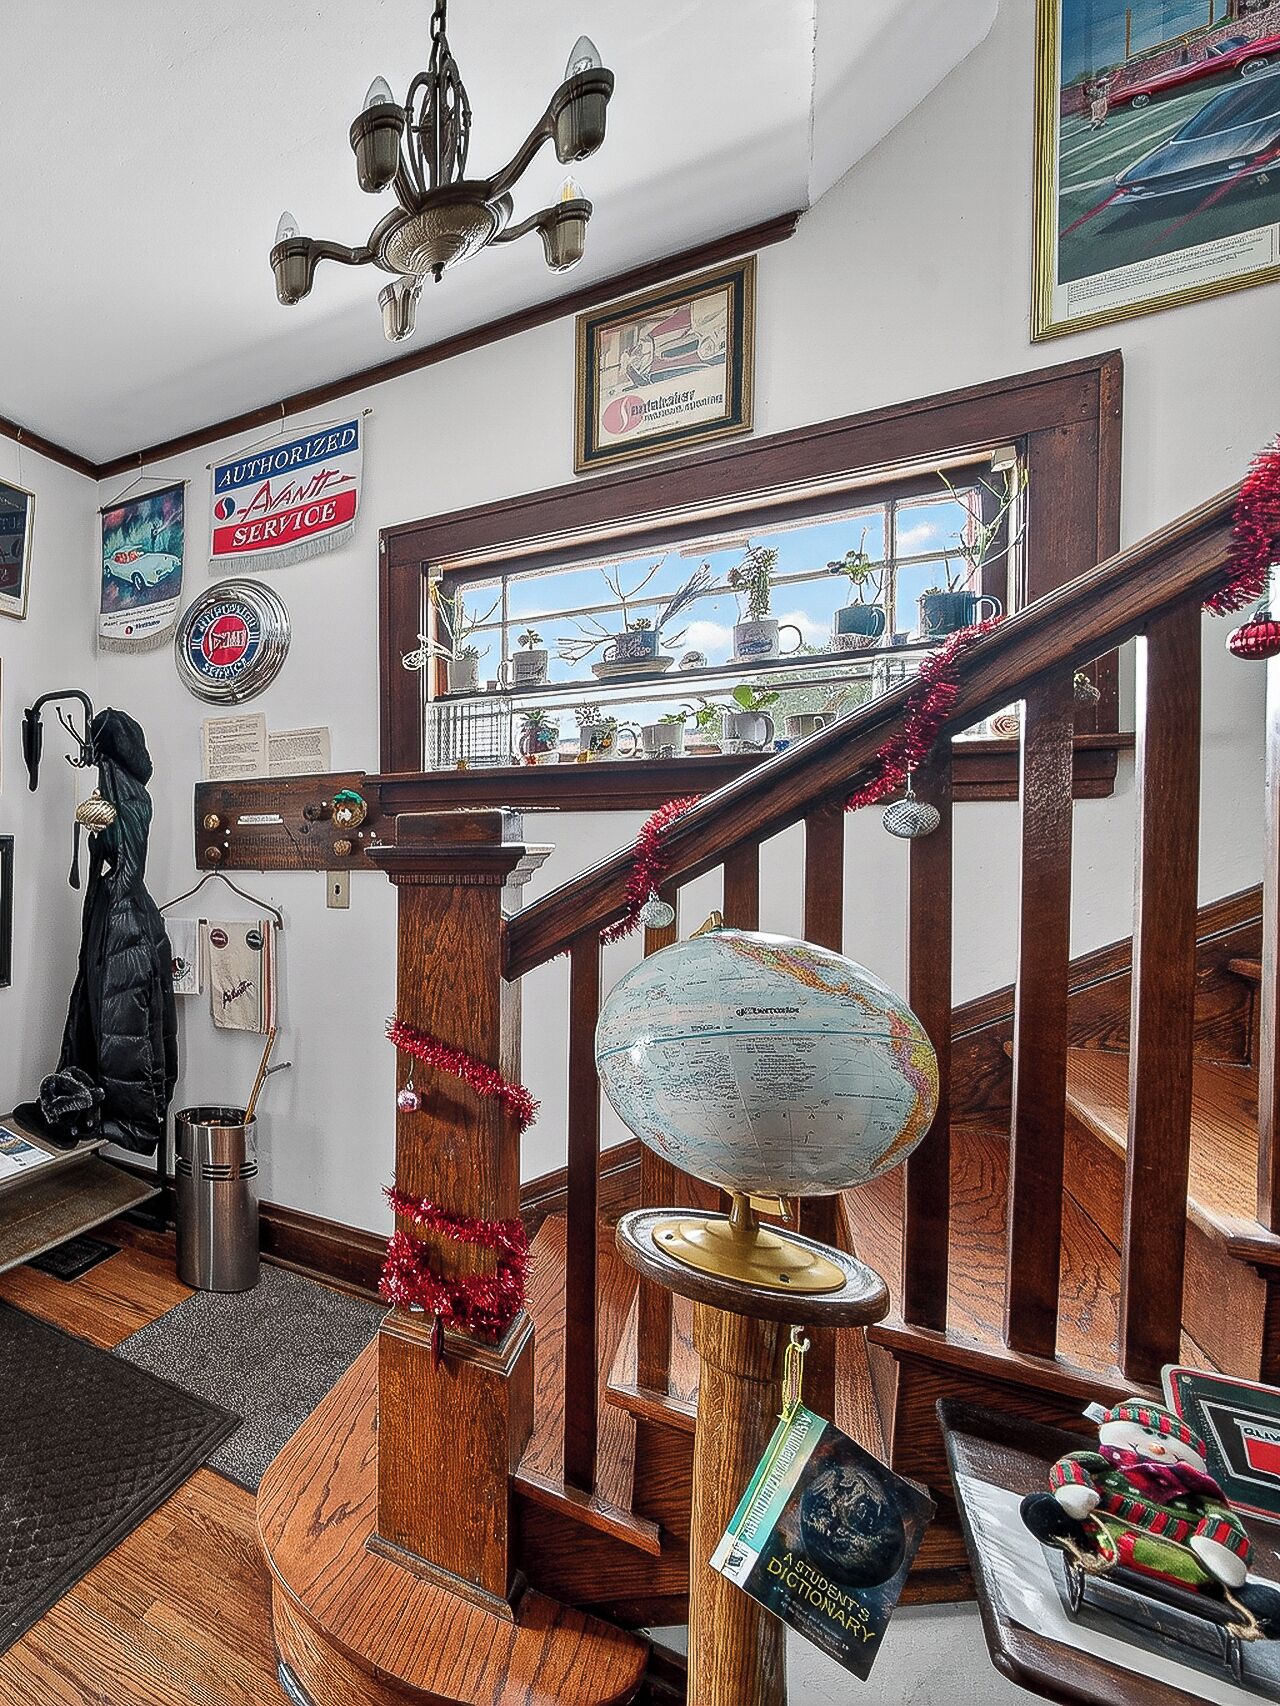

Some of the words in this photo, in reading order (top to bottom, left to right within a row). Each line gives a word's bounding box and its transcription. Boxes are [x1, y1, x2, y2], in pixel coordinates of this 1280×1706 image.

[218, 428, 356, 488] AUTHORIZED
[232, 501, 336, 547] SERVICE
[766, 1556, 876, 1644] DICTIONARY
[782, 1552, 793, 1565] A
[794, 1560, 872, 1622] STUDENT'S
